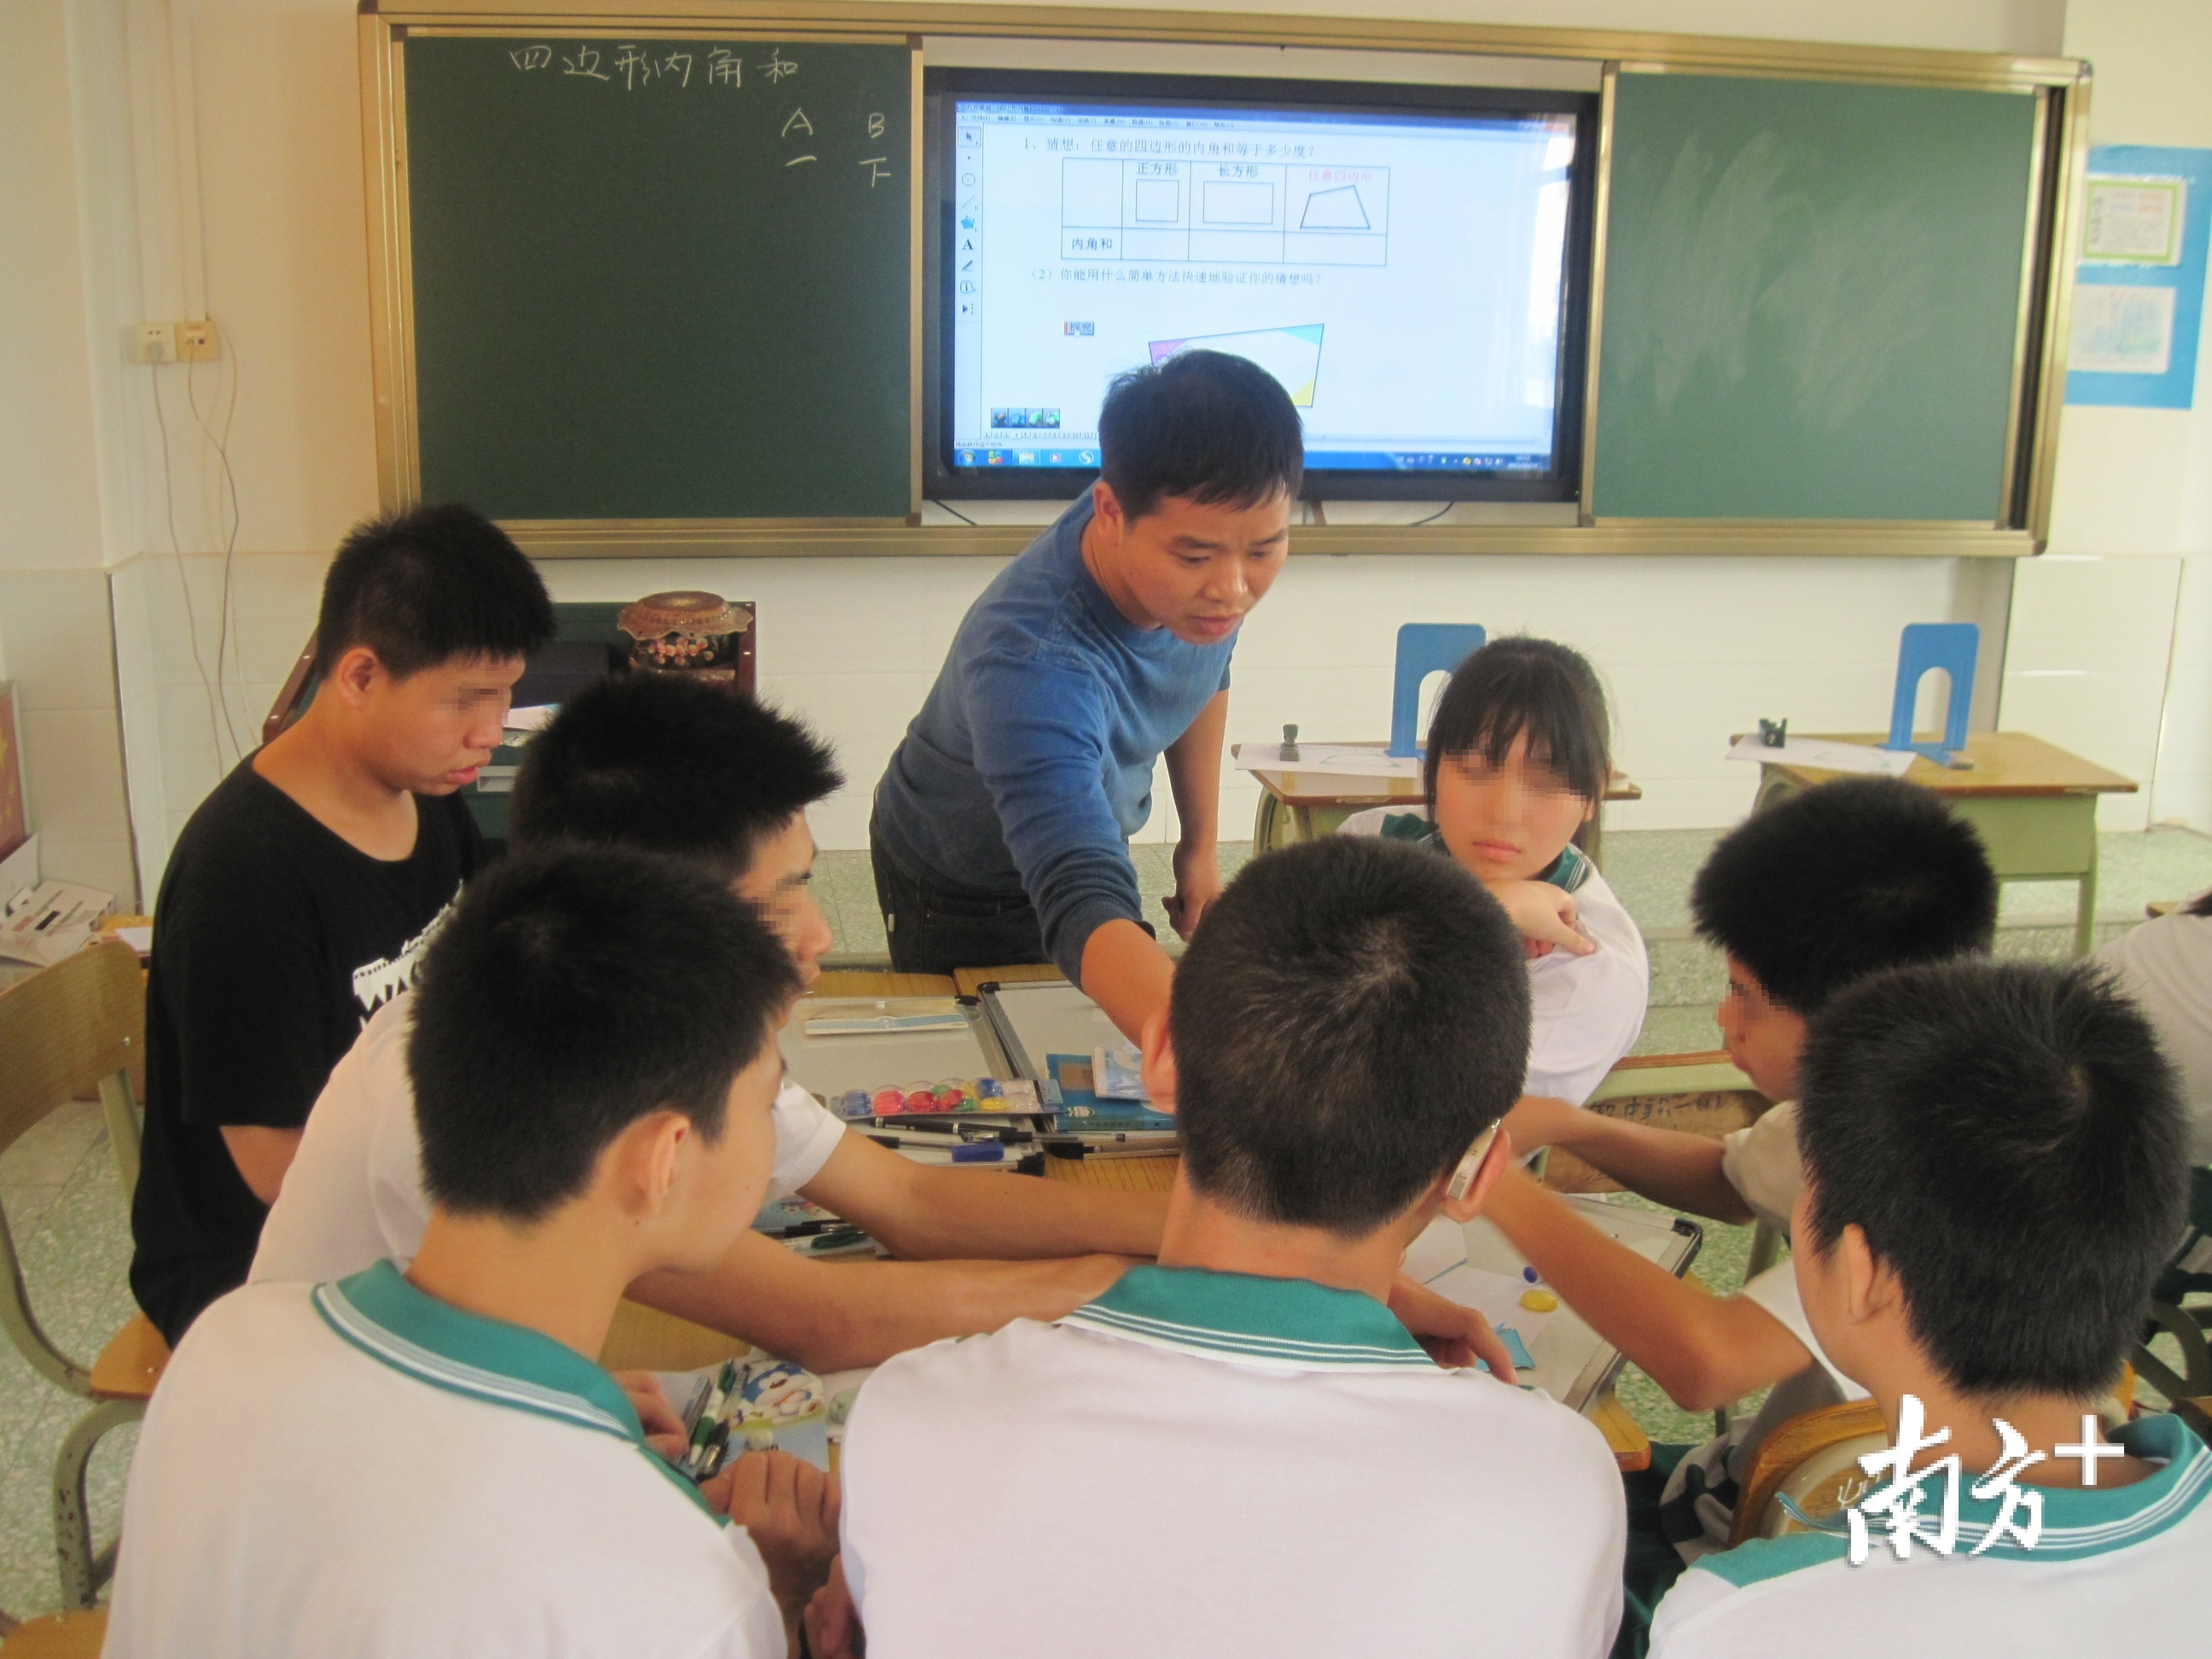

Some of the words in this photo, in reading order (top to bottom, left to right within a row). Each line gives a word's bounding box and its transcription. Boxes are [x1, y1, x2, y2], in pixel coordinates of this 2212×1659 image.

[509, 44, 798, 90] 四边形内角和
[782, 108, 814, 137] A
[868, 113, 885, 139] B
[1136, 161, 1178, 175] 正方形
[1217, 163, 1259, 178] 长方形
[1072, 236, 1113, 250] 内角和
